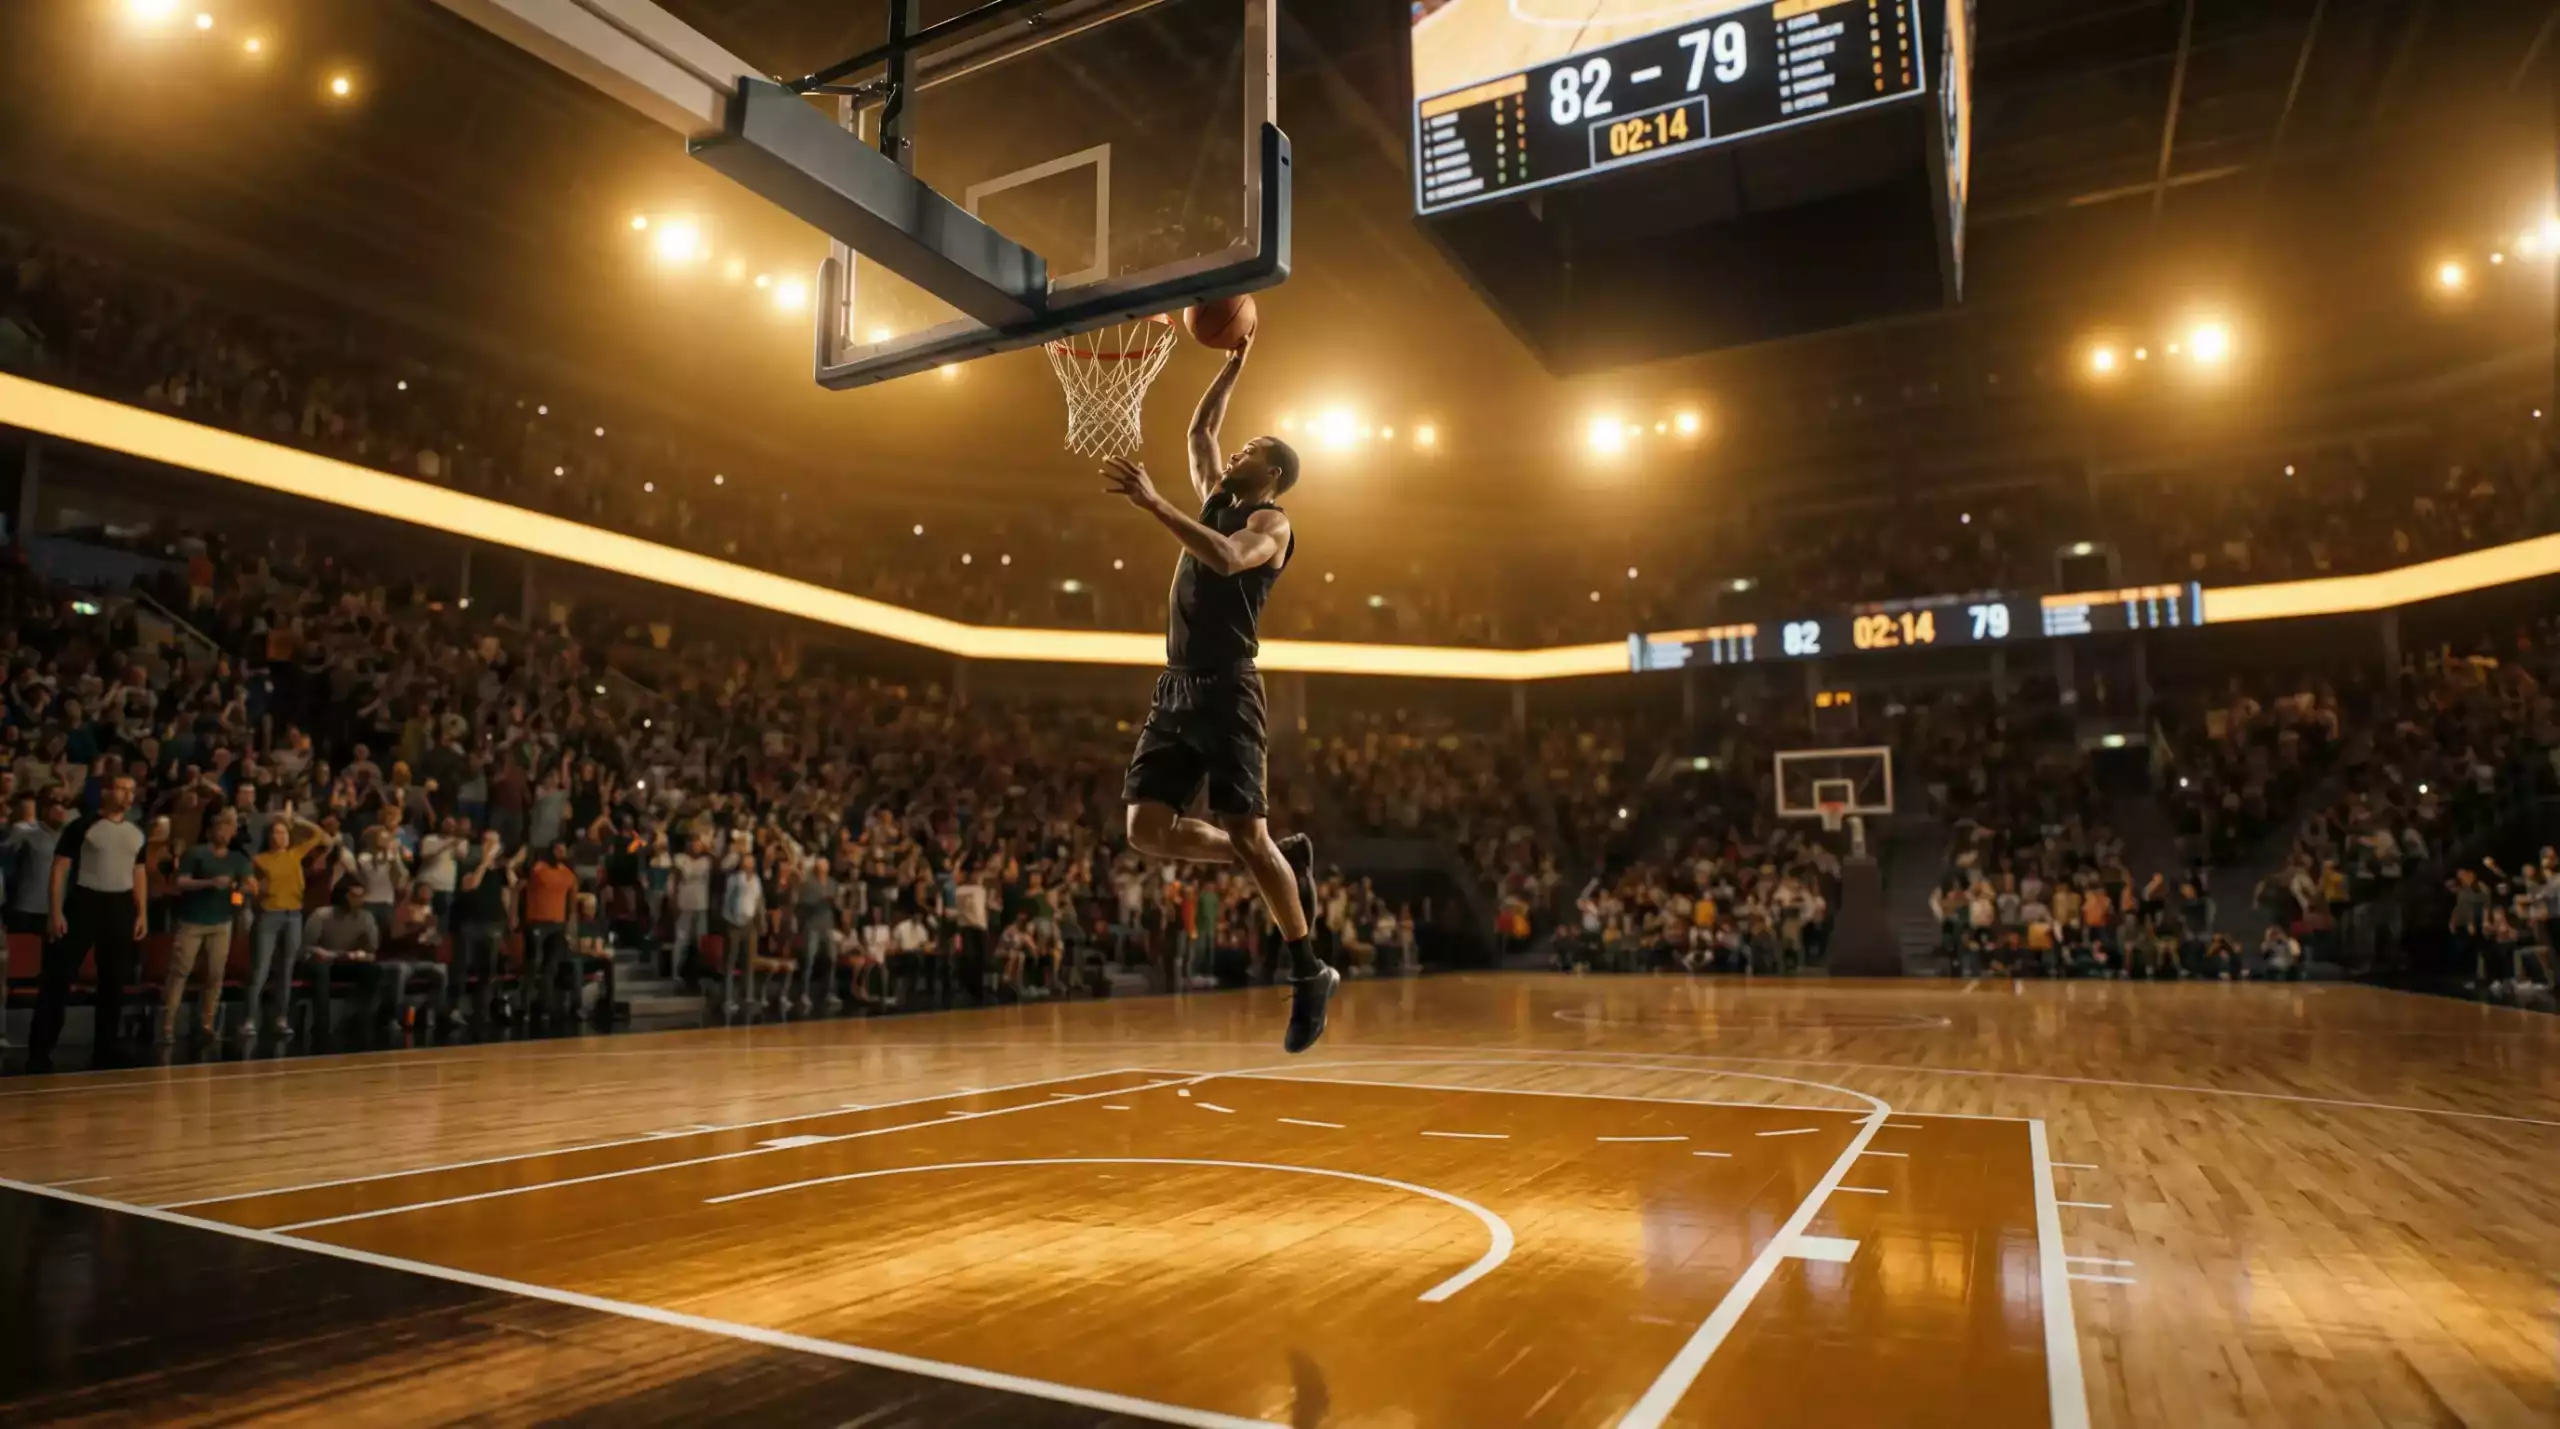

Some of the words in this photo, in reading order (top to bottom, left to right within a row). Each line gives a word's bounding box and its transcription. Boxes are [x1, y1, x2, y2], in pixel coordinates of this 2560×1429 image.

[1550, 57, 1613, 125] 82
[1678, 21, 1748, 92] 79
[1609, 107, 1688, 156] 02:14
[1853, 610, 1936, 649] 02:14
[1967, 603, 2010, 640] 79
